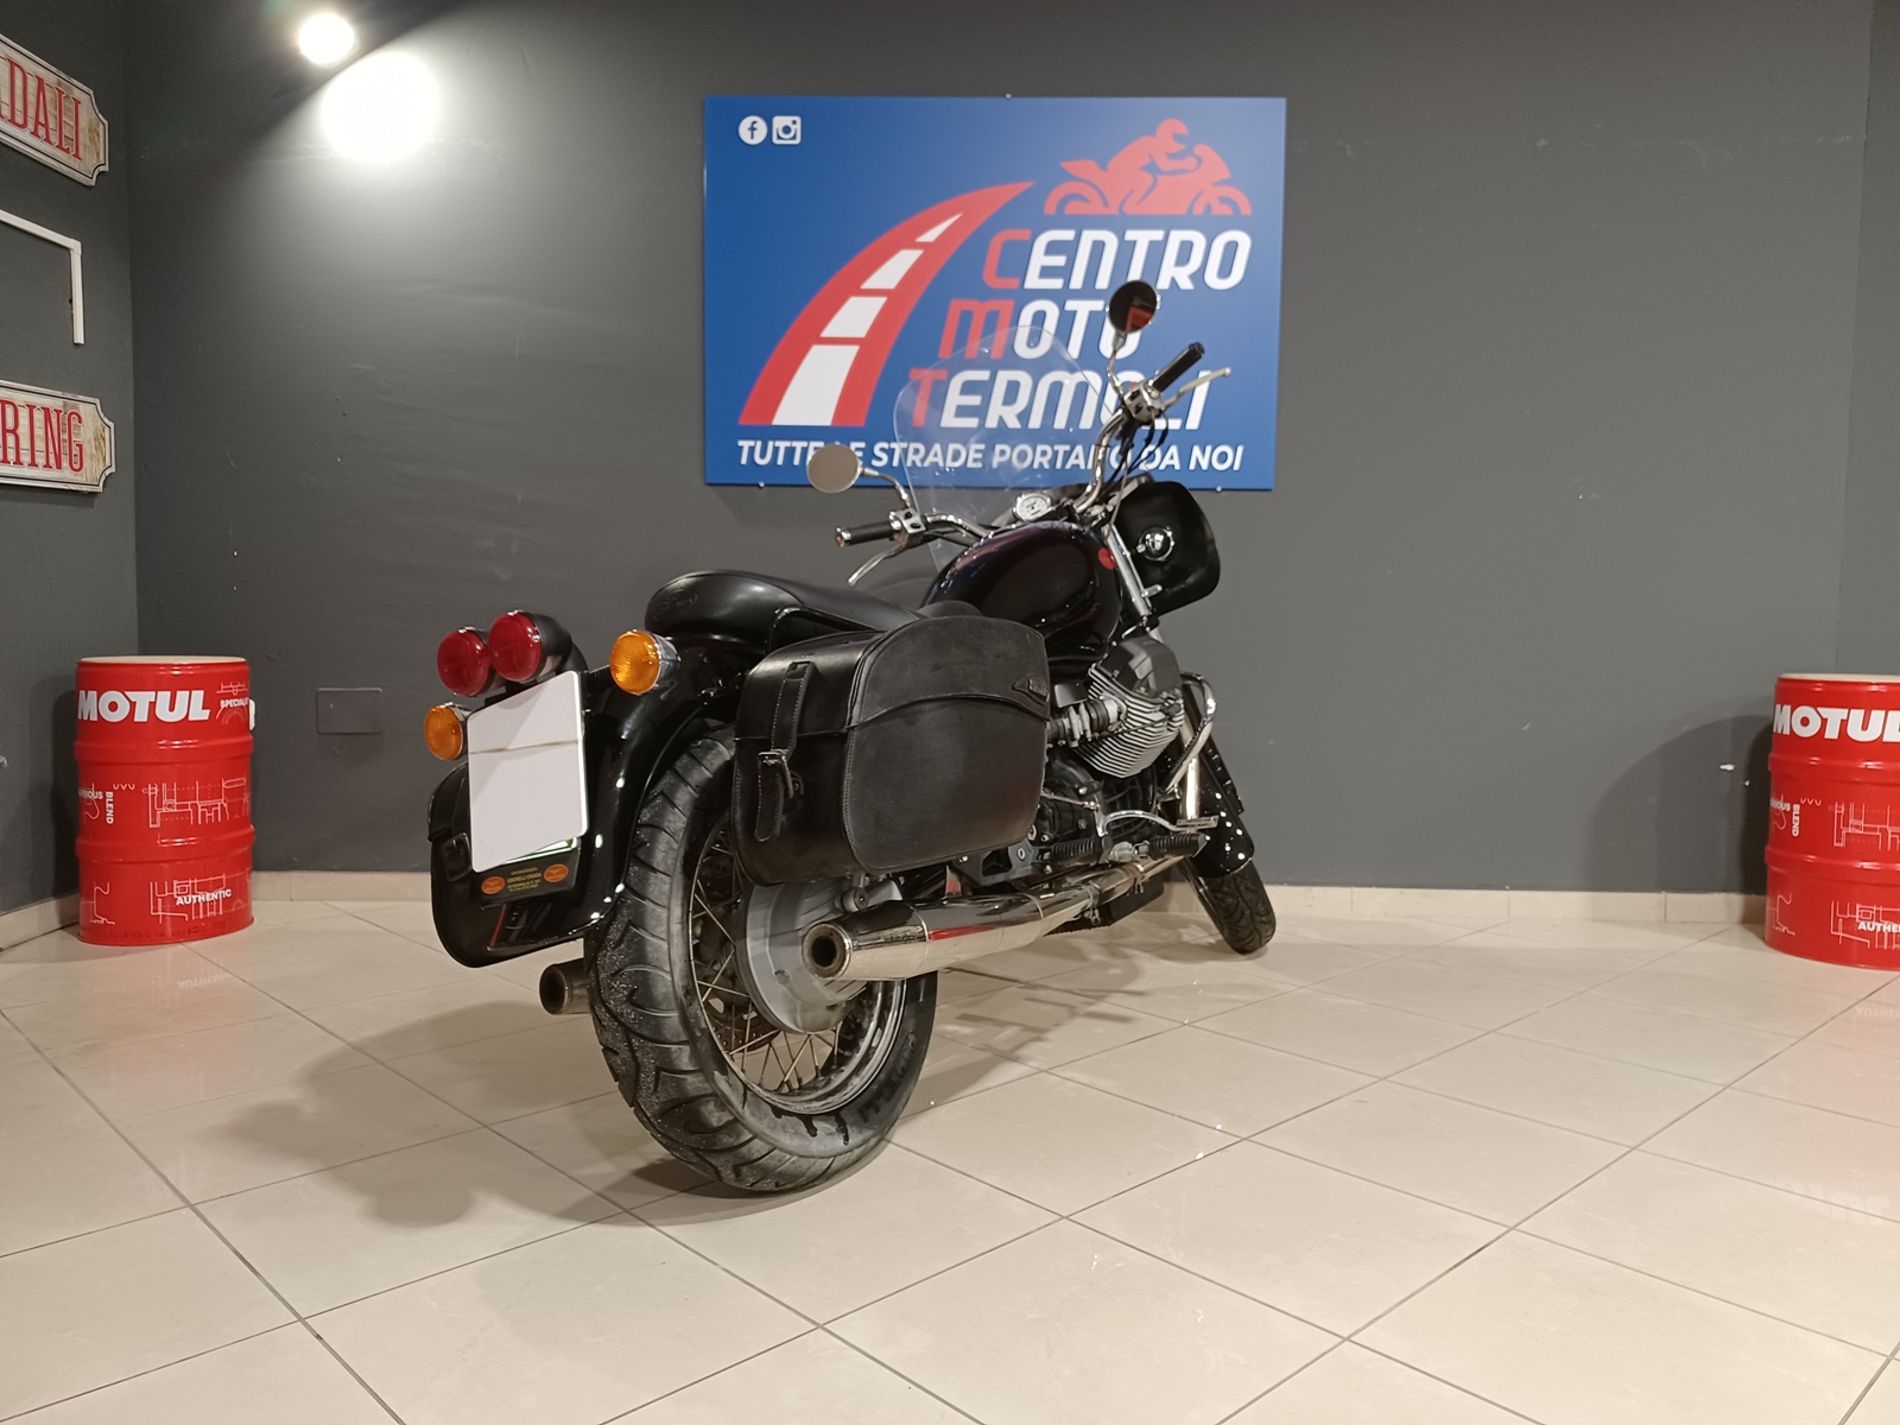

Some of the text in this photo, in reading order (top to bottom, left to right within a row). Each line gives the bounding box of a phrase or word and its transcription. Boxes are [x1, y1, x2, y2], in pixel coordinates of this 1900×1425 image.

[0, 58, 82, 161] DALI
[982, 229, 1252, 290] CENTRO
[871, 441, 985, 468] STRADE
[1138, 444, 1181, 471] DA
[1188, 444, 1244, 471] NOI
[78, 690, 211, 723] MOTUL
[105, 791, 114, 825] BLEND
[175, 888, 232, 906] AUTHENTIC
